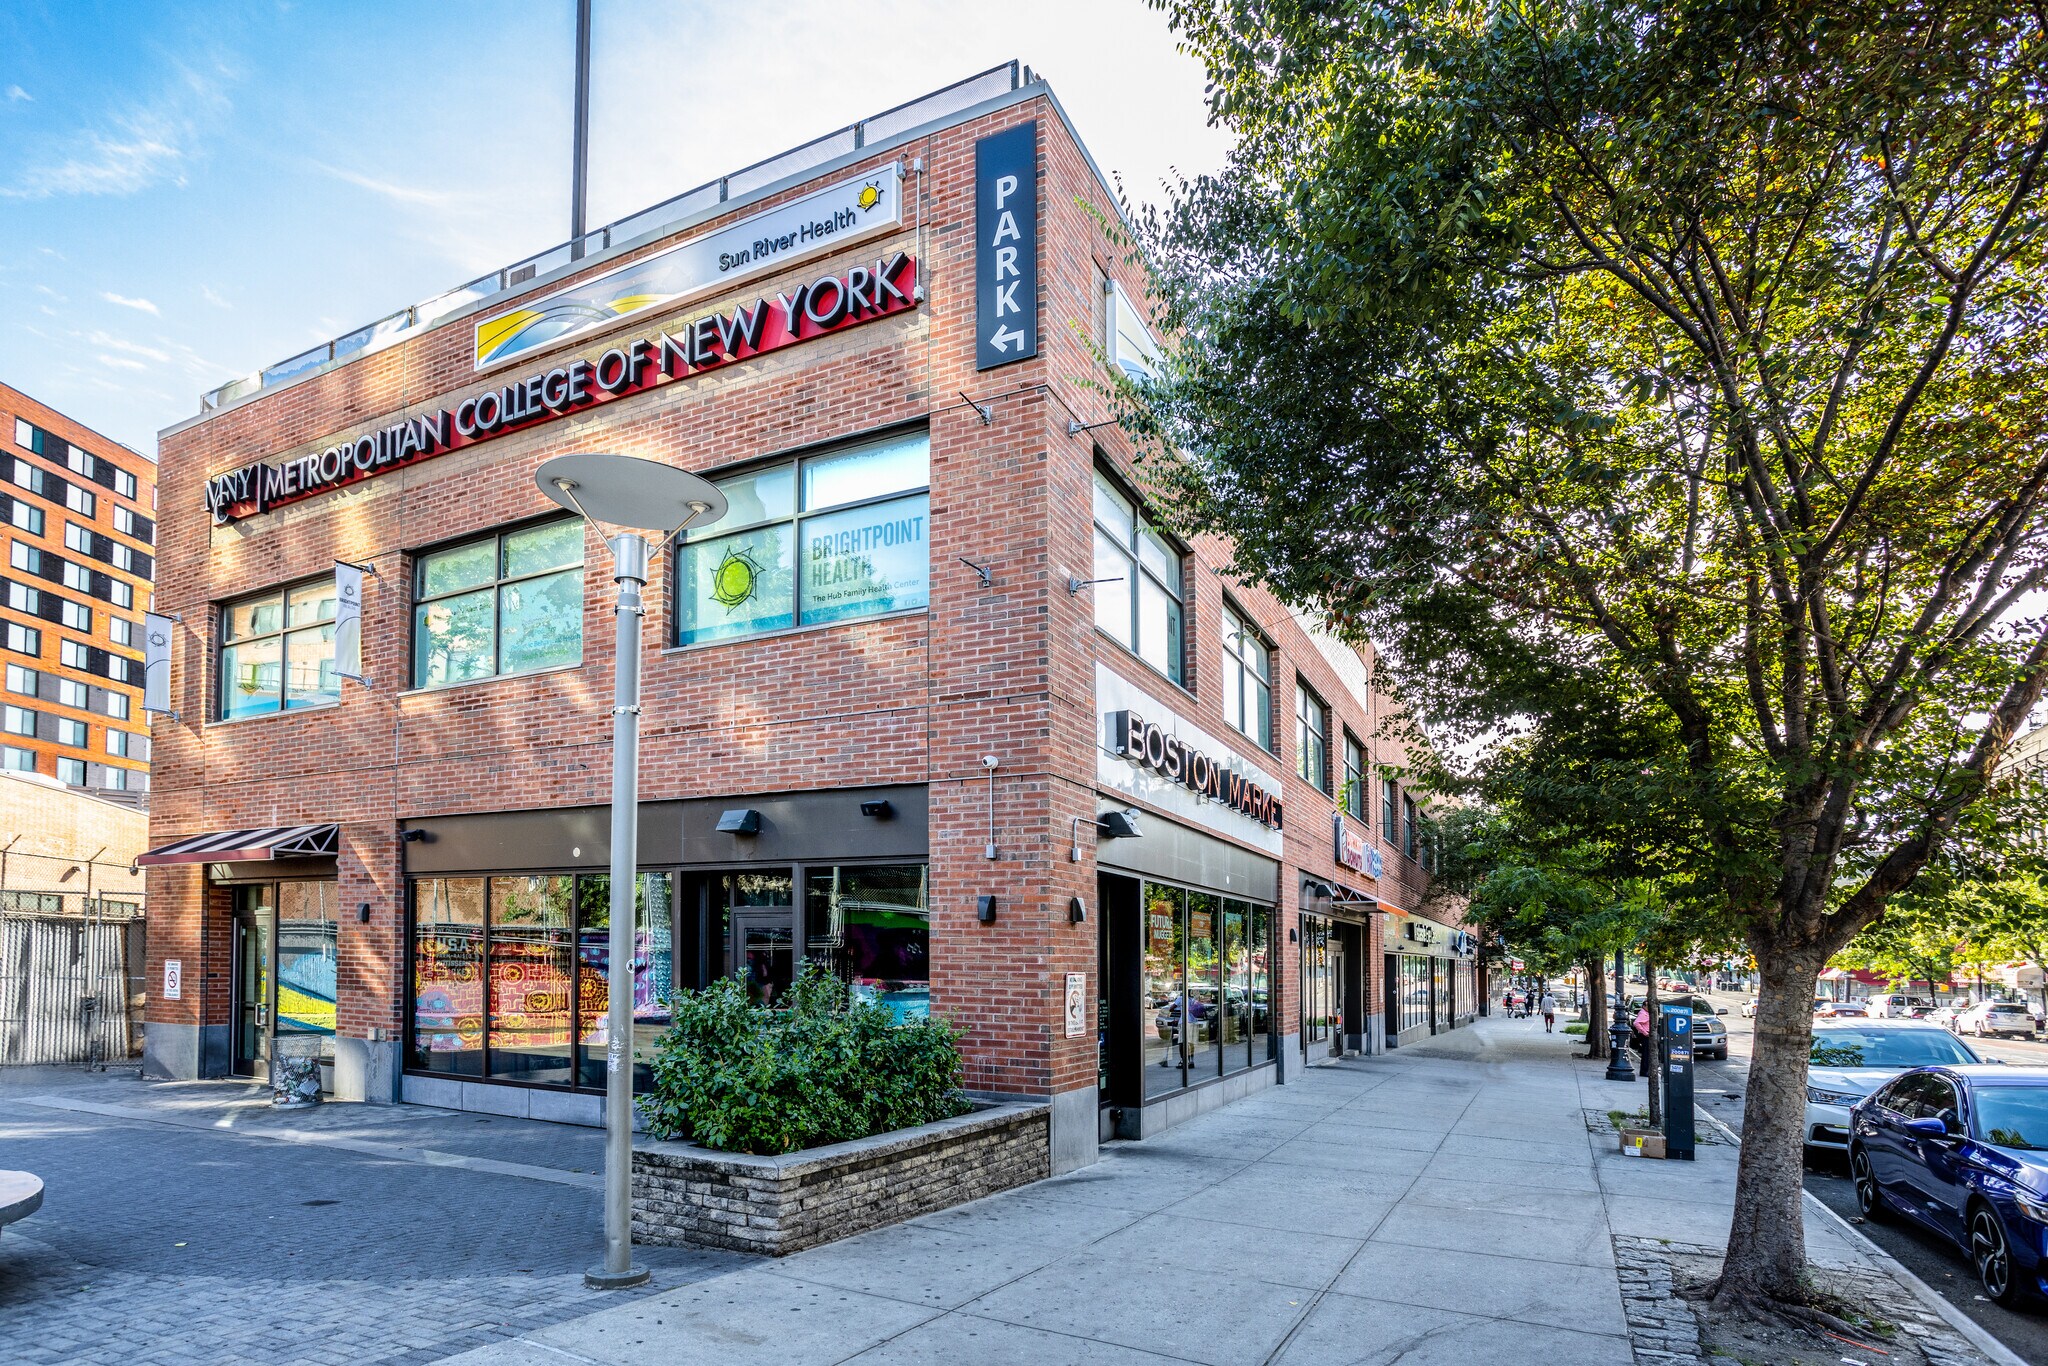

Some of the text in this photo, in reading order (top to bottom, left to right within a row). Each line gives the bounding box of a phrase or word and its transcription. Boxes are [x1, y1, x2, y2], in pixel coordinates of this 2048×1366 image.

[718, 207, 856, 272] Sun River Health
[992, 174, 1022, 318] PARK
[264, 408, 447, 501] METROPOLITAN
[454, 360, 588, 437] COLLEGE
[595, 338, 650, 390] OF
[660, 298, 768, 374] NEW
[776, 251, 912, 335] YORK
[812, 516, 923, 561] BRIGHTPOINT
[812, 554, 872, 588] HEALTH
[827, 591, 842, 600] Hub
[843, 587, 867, 599] Family
[868, 583, 893, 593] Health
[893, 579, 920, 589] Center
[1127, 709, 1286, 830] BOSTON MARKET
[1675, 1017, 1687, 1032] P
